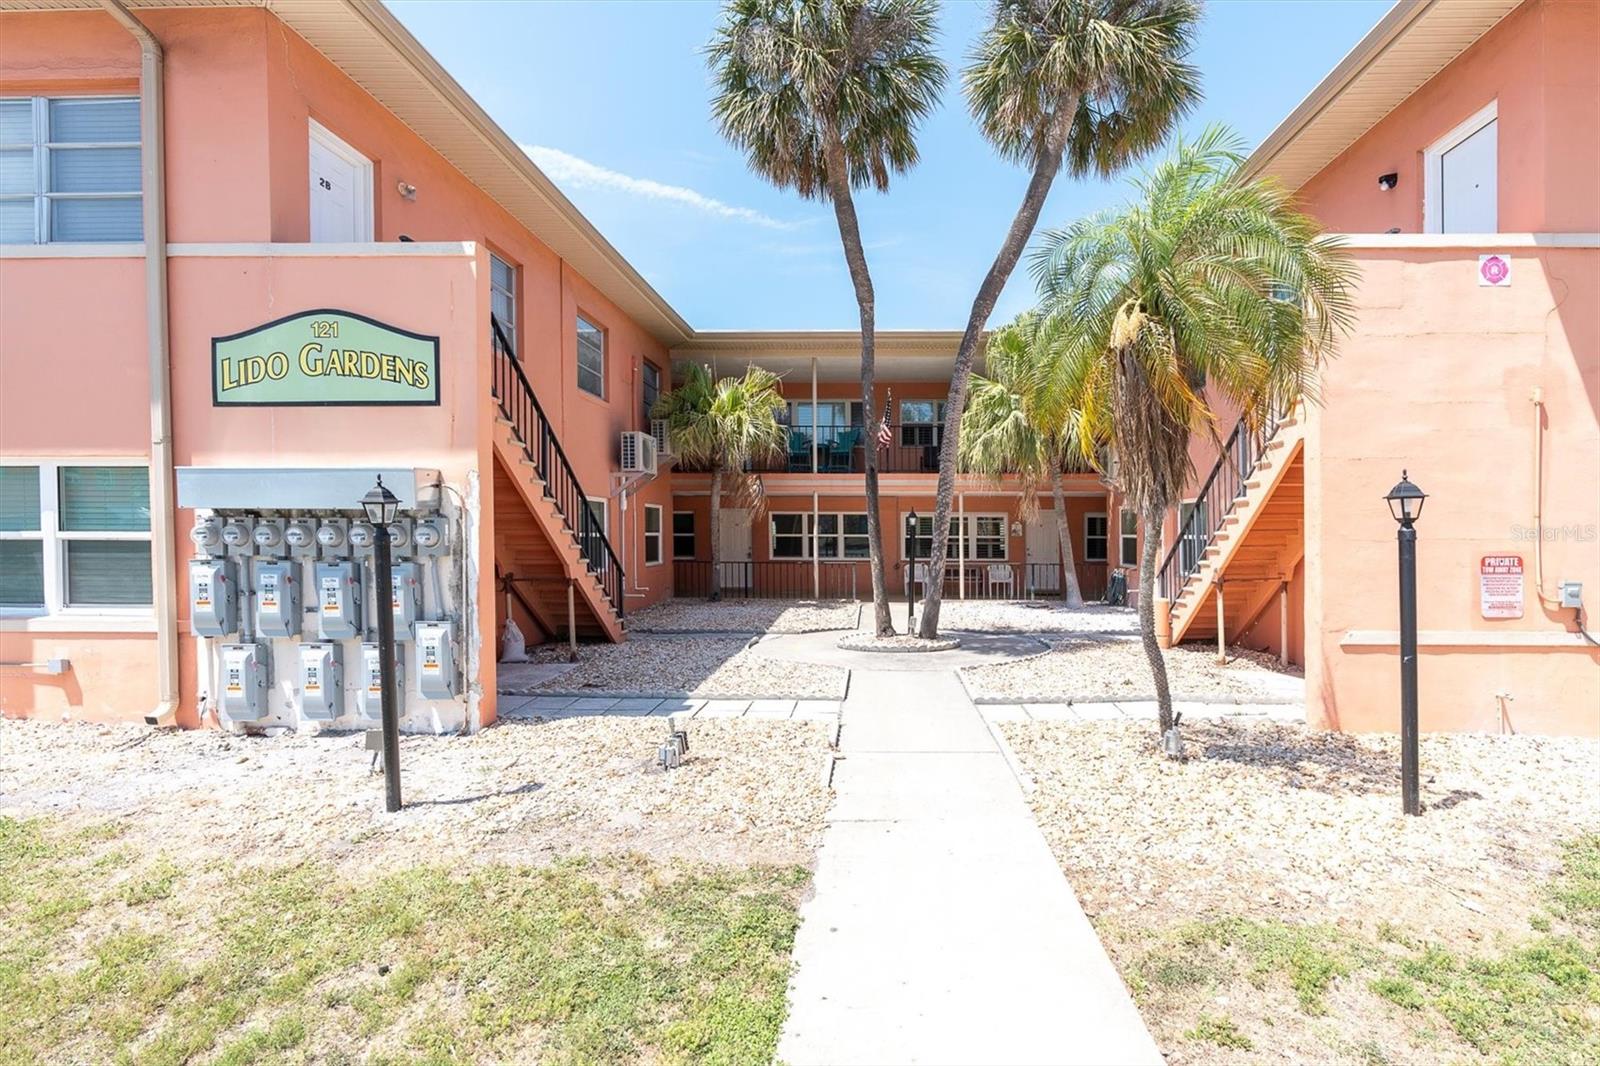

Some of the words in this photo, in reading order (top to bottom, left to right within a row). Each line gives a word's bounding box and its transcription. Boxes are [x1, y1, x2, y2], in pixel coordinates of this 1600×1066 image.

[319, 177, 331, 191] 2B
[311, 321, 339, 338] 121
[221, 351, 289, 392] LIDO
[299, 342, 430, 389] GARDENS
[1484, 557, 1519, 567] PRIVATE
